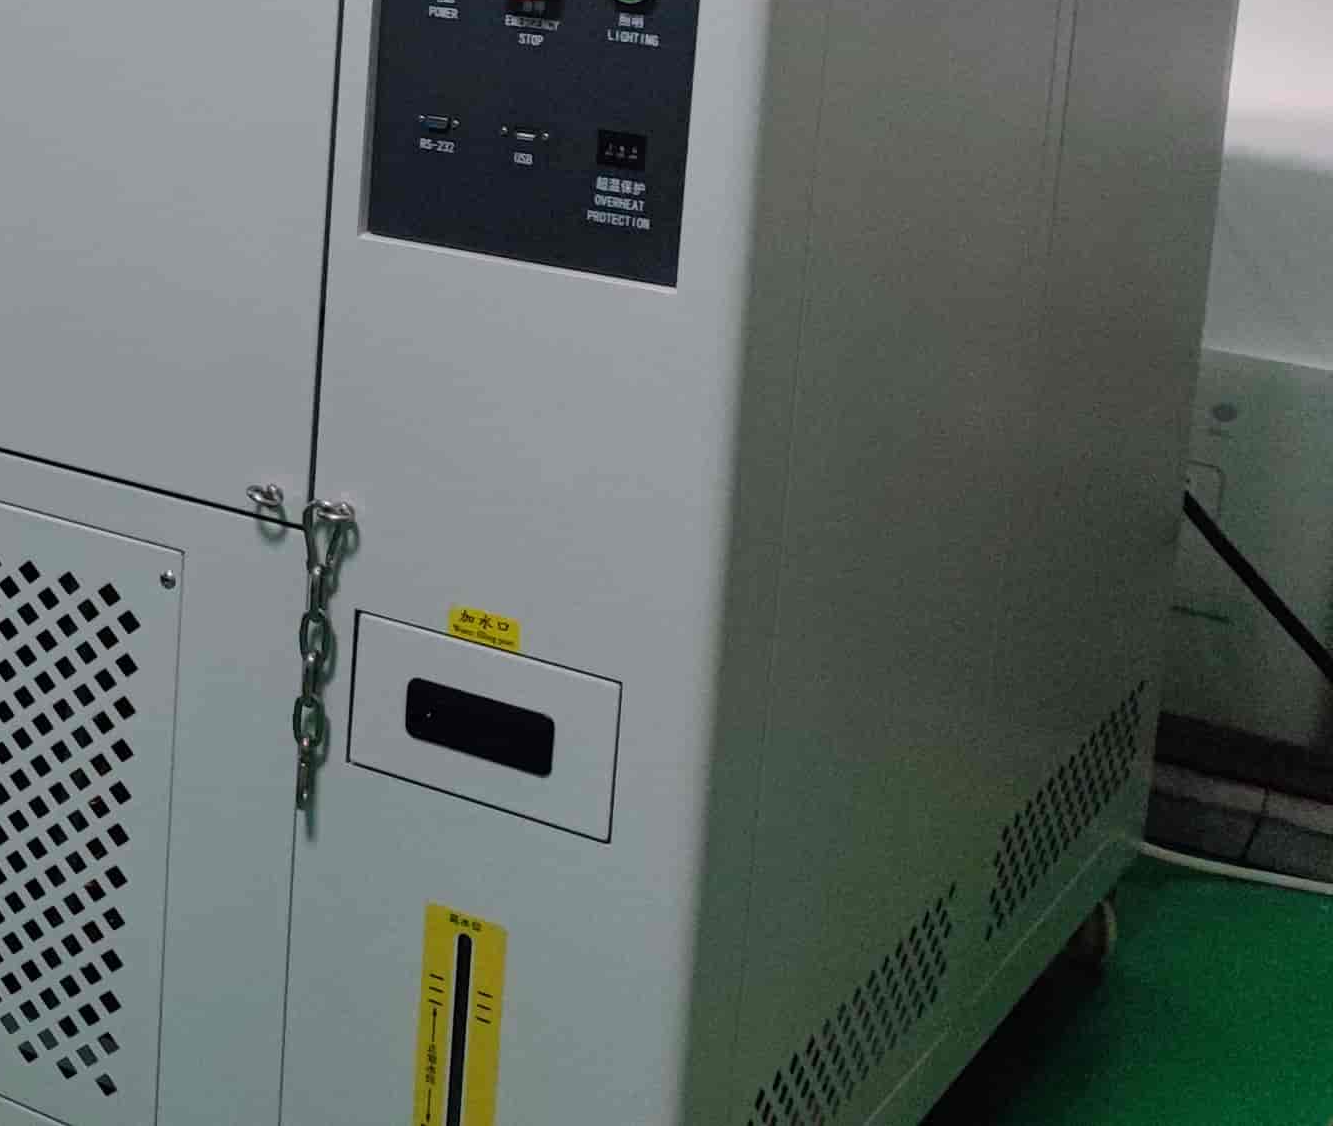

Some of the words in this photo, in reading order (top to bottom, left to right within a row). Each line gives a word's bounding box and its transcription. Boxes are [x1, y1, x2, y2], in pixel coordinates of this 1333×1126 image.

[428, 5, 459, 19] POWER
[518, 33, 544, 46] STOP
[607, 28, 660, 47] LIGHTING
[419, 138, 455, 154] RS-232
[596, 176, 646, 195] 超温保护
[594, 194, 645, 211] OVERHEAT
[586, 210, 651, 230] PROTECTION
[460, 609, 510, 632] 加水口
